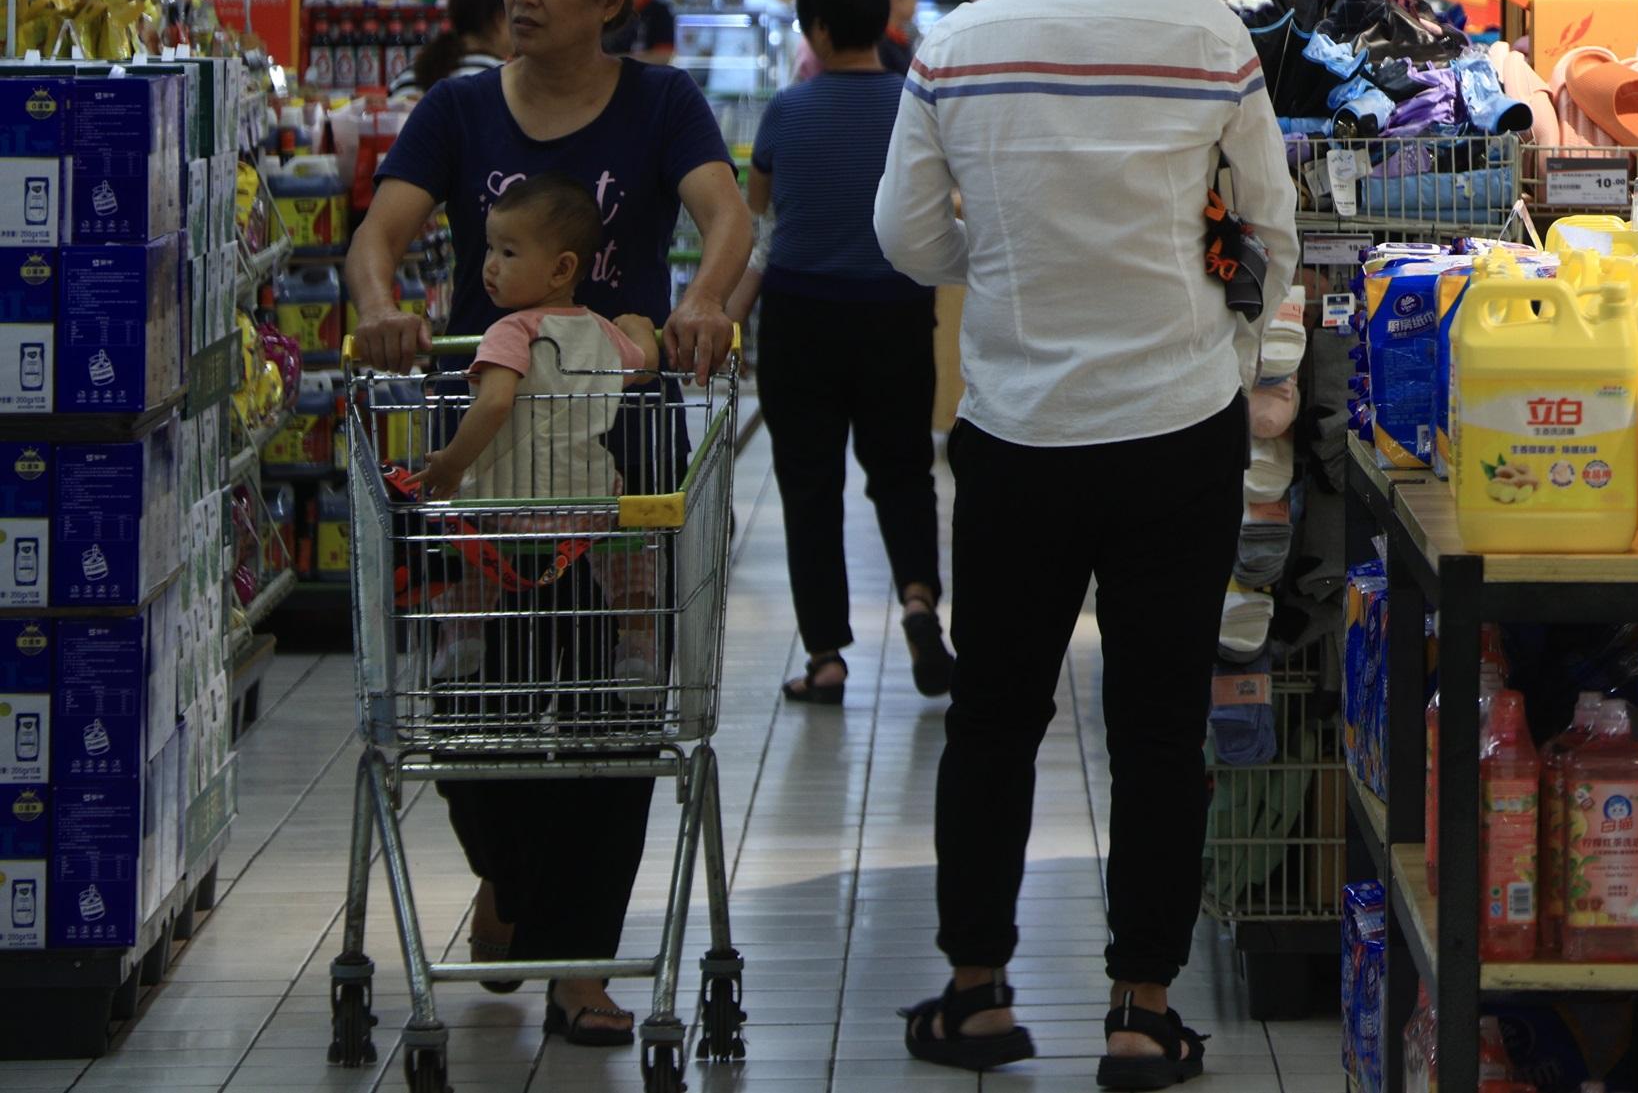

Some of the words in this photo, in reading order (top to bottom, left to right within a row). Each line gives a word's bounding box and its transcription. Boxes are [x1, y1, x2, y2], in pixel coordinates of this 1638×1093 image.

[1595, 177, 1626, 188] 10.00
[1387, 309, 1436, 333] 厨房纸巾
[1526, 397, 1583, 426] 立白
[1601, 817, 1633, 833] 白猫
